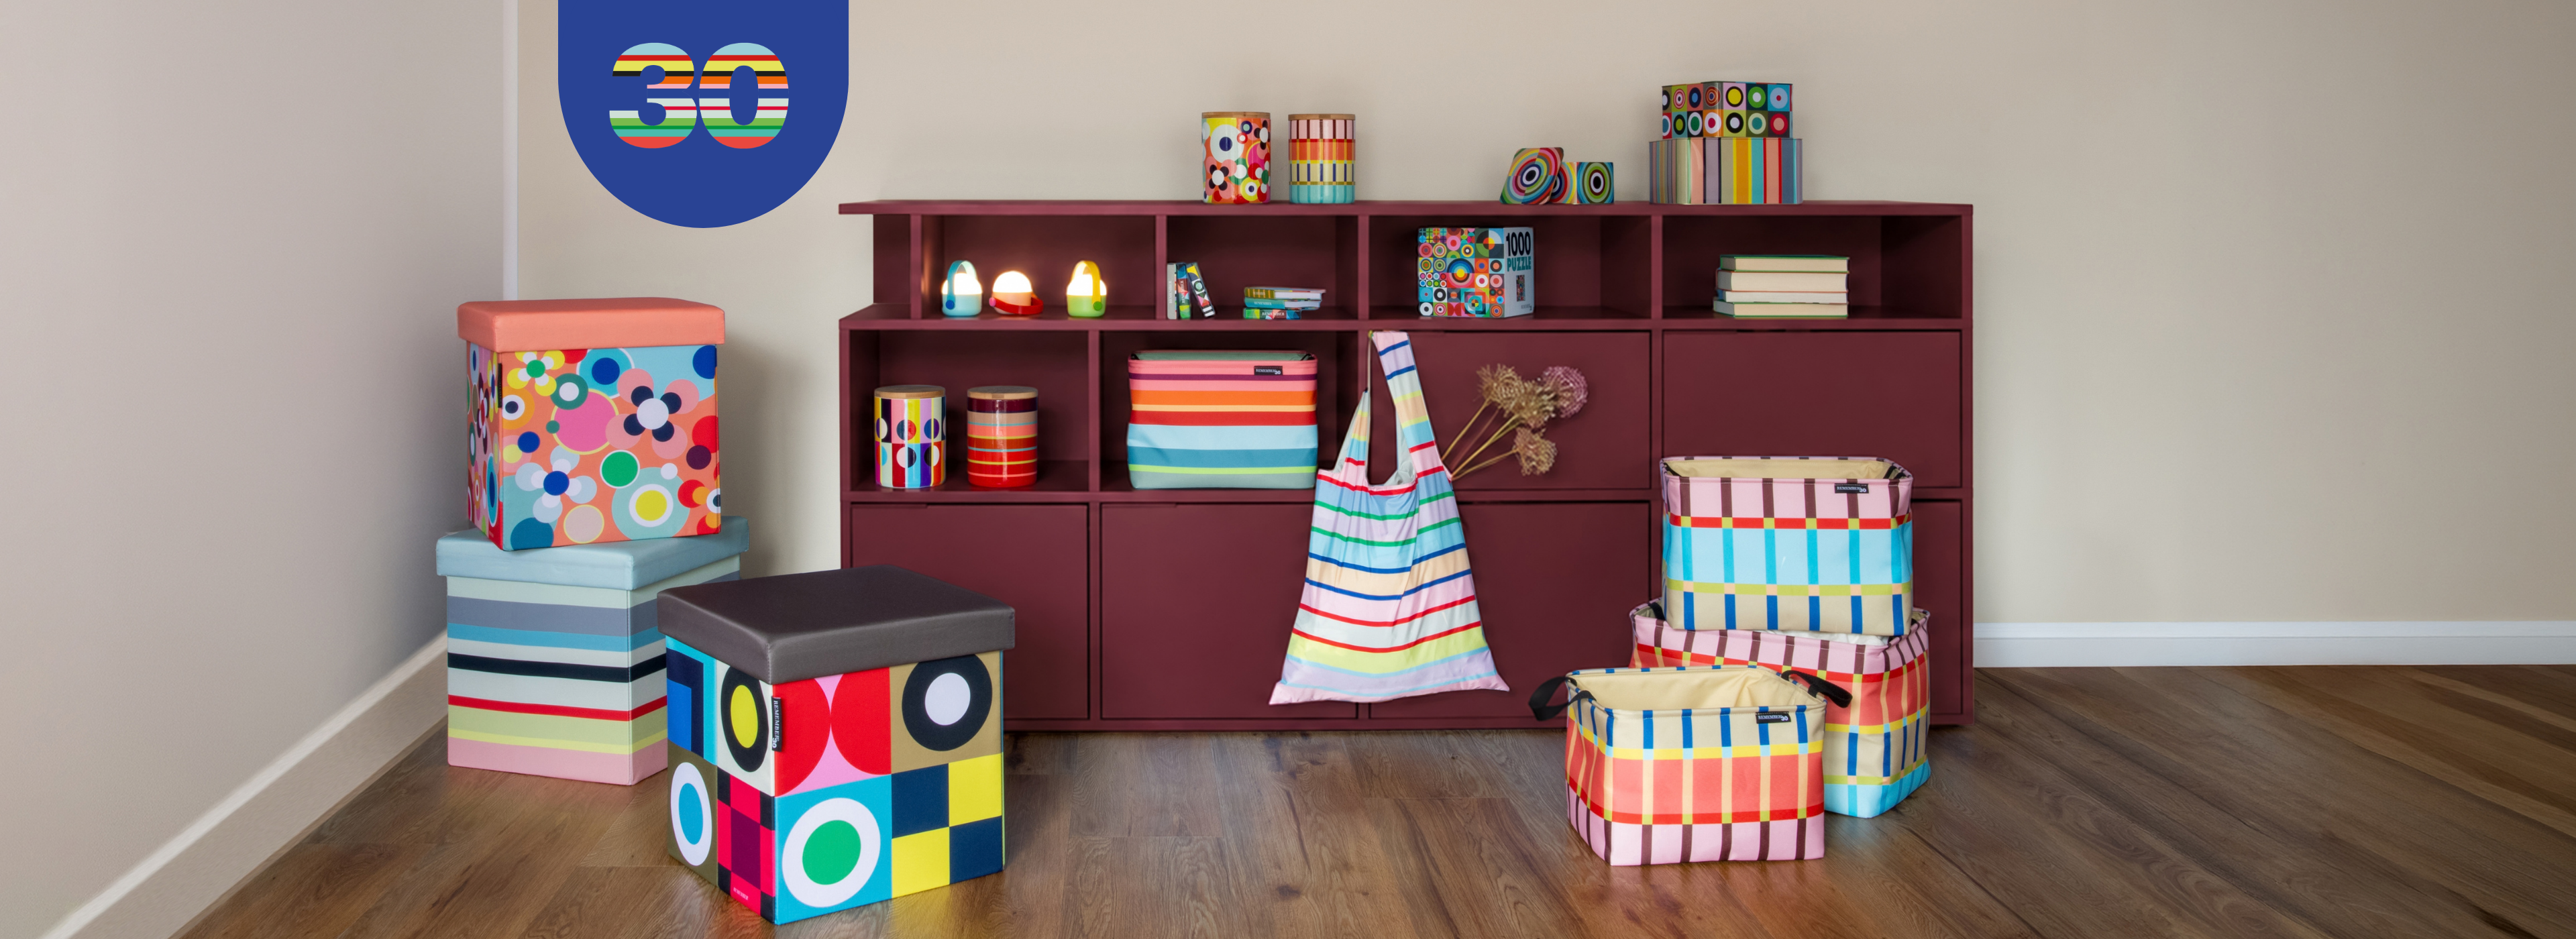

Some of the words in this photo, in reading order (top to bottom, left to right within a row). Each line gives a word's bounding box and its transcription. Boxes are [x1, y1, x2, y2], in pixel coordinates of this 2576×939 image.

[1506, 231, 1531, 256] 1000
[1507, 256, 1532, 272] PUZZLE
[772, 738, 777, 749] 30
